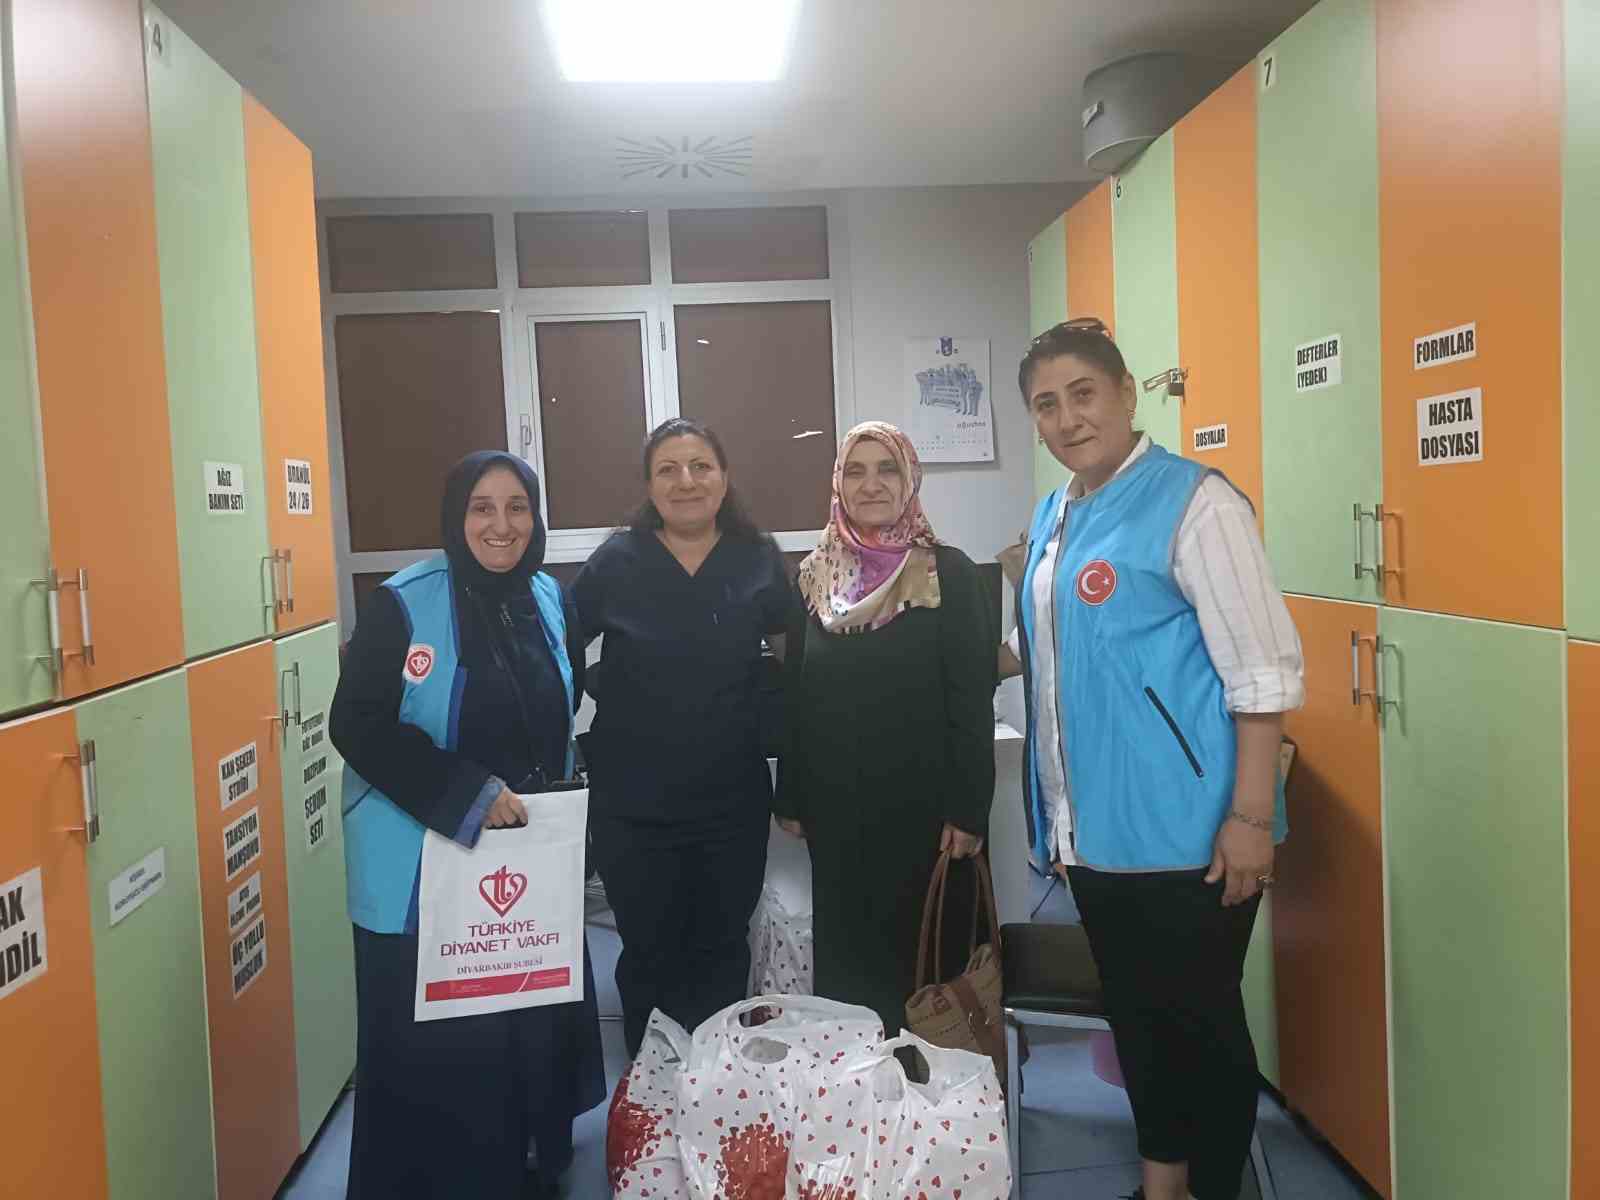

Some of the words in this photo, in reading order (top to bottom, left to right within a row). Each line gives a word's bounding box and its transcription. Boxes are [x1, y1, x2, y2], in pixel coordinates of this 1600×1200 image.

[153, 23, 162, 56] 4
[1263, 57, 1273, 86] 7
[1115, 179, 1122, 199] 6
[1297, 339, 1338, 366] DEFTERLER
[1416, 330, 1474, 363] FORMLAR
[1297, 366, 1327, 389] (YEDEK)
[1428, 397, 1473, 426] HASTA
[1195, 428, 1226, 448] DOSYALAR
[1420, 430, 1480, 460] DOSYASI
[208, 493, 230, 510] BAKIM
[221, 759, 236, 781] KAN
[468, 919, 536, 938] TÜRKİYE
[440, 938, 510, 957] DİYANET
[517, 932, 560, 949] VAKFI
